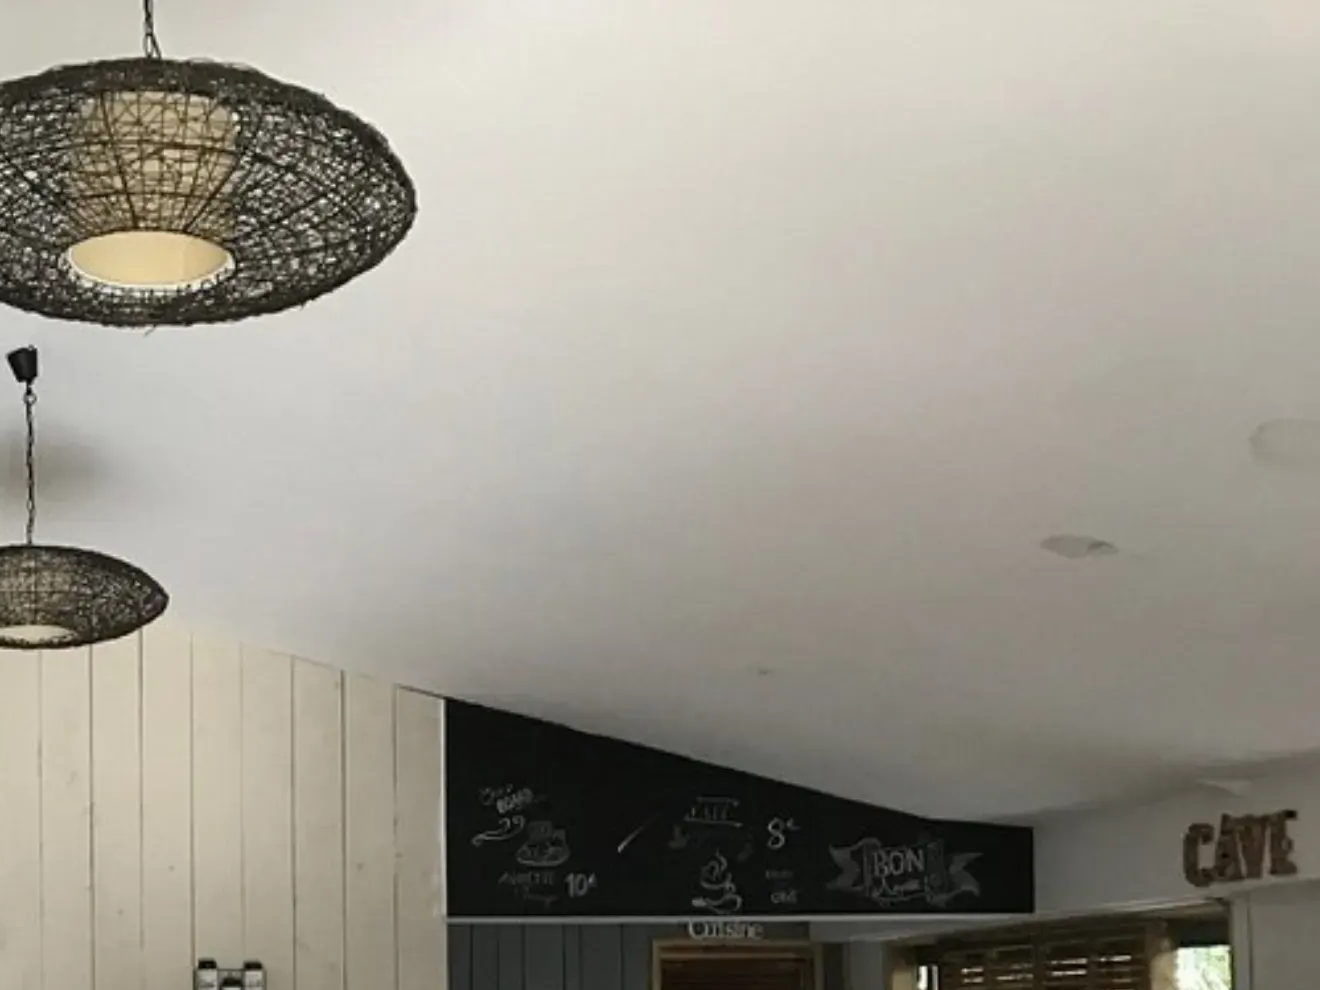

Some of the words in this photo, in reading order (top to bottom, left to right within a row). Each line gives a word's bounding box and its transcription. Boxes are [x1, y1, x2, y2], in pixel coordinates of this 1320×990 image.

[873, 848, 926, 878] BON
[1183, 809, 1298, 888] CAVE
[688, 920, 764, 940] Cuisine
